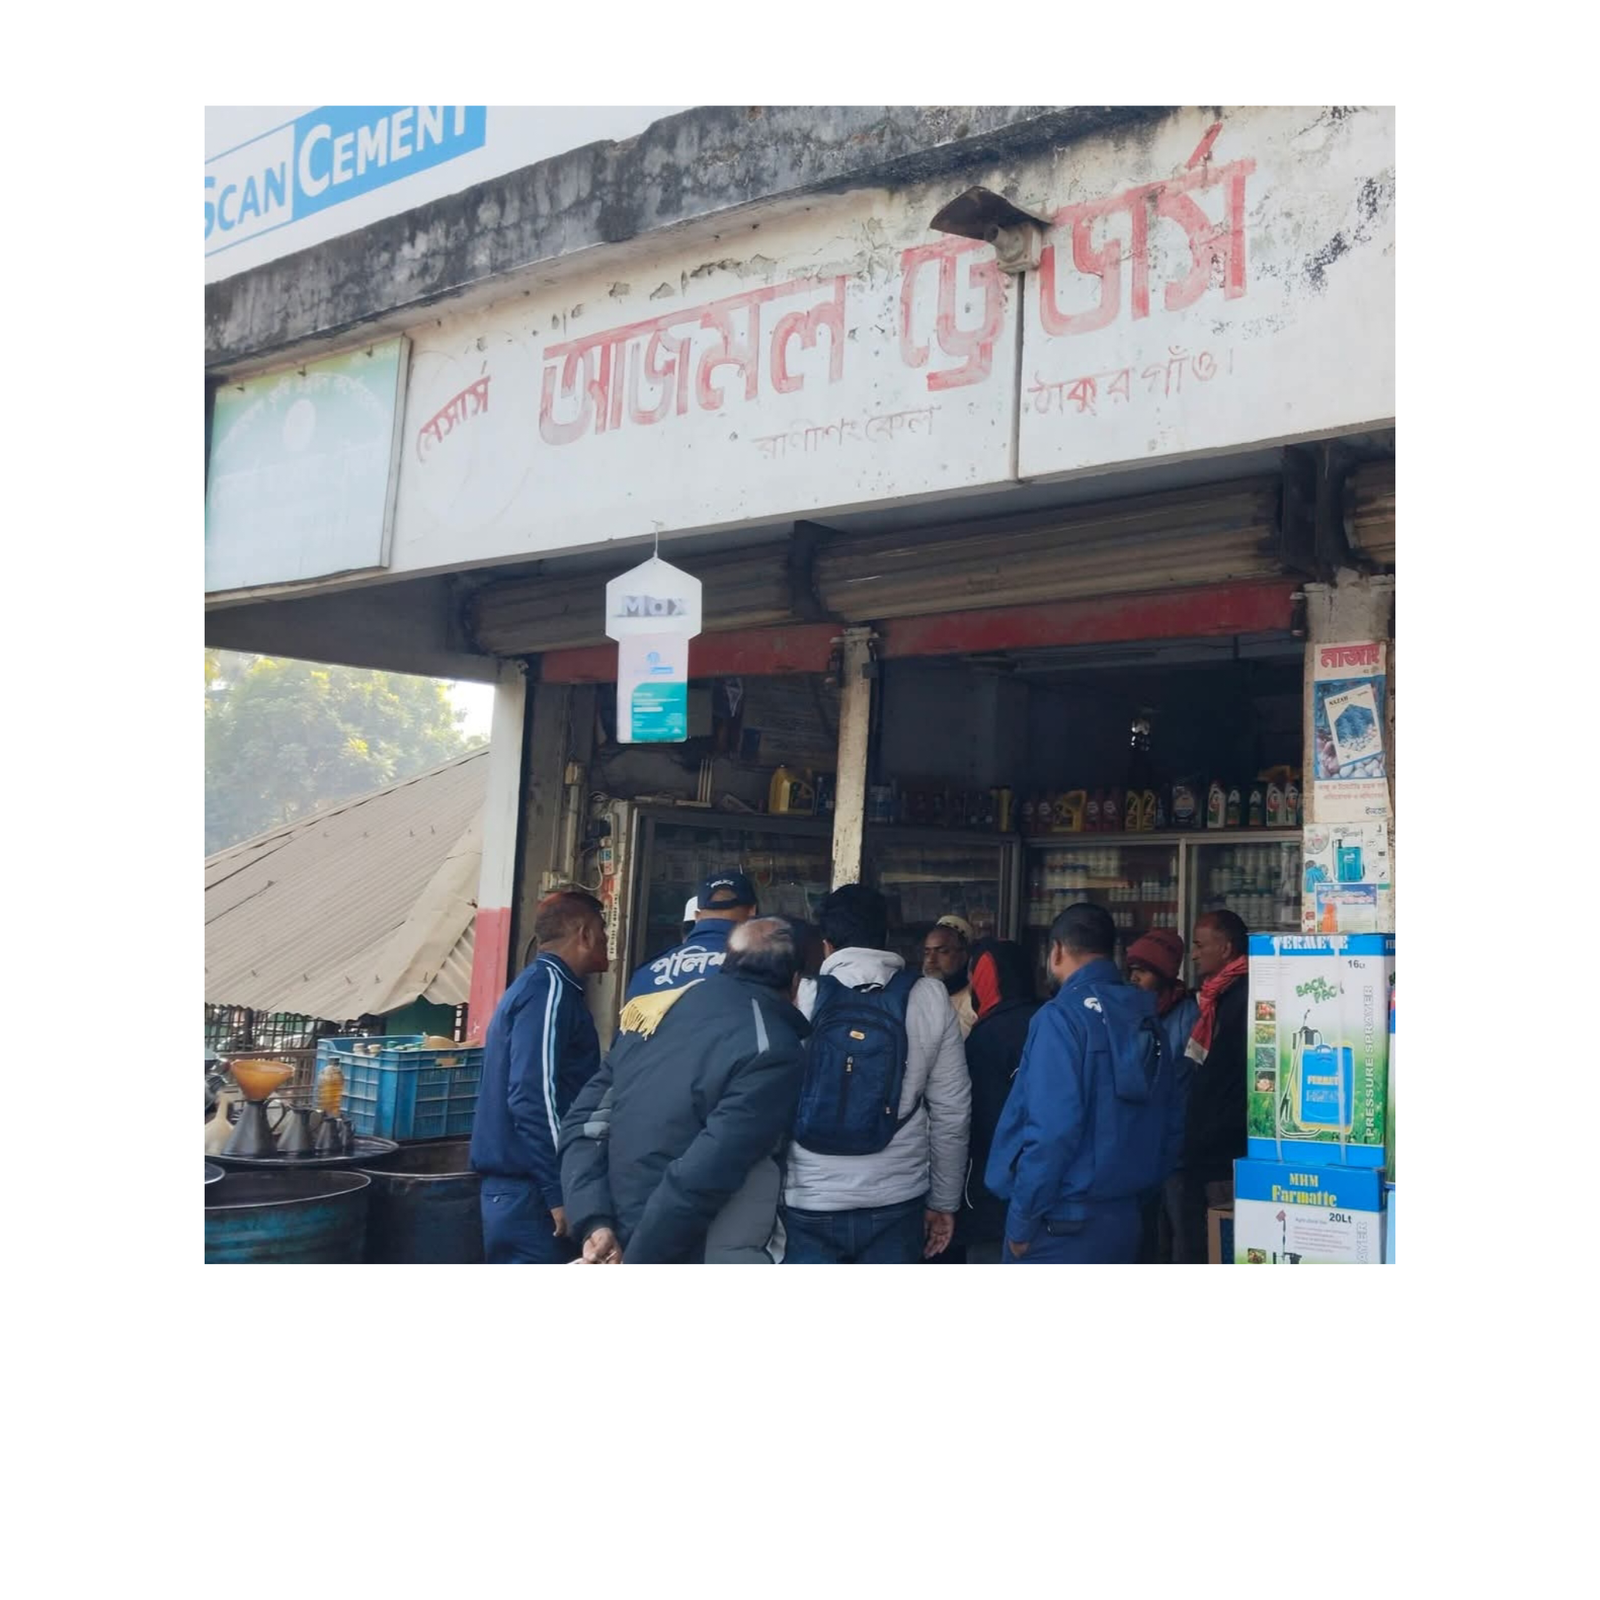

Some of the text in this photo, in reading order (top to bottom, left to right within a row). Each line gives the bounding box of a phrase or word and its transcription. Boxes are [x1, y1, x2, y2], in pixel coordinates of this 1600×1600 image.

[298, 105, 466, 197] CEMENT
[416, 360, 491, 463] মেসার্স
[539, 274, 850, 446] আজমল
[901, 122, 1257, 392] ট্রেডার্স
[1295, 976, 1327, 998] BACK
[1363, 985, 1375, 1138] PRESSURE SPRAYER
[1271, 1185, 1338, 1208] Farmatte
[1289, 1173, 1319, 1188] MHM
[1356, 1221, 1368, 1264] AYER
